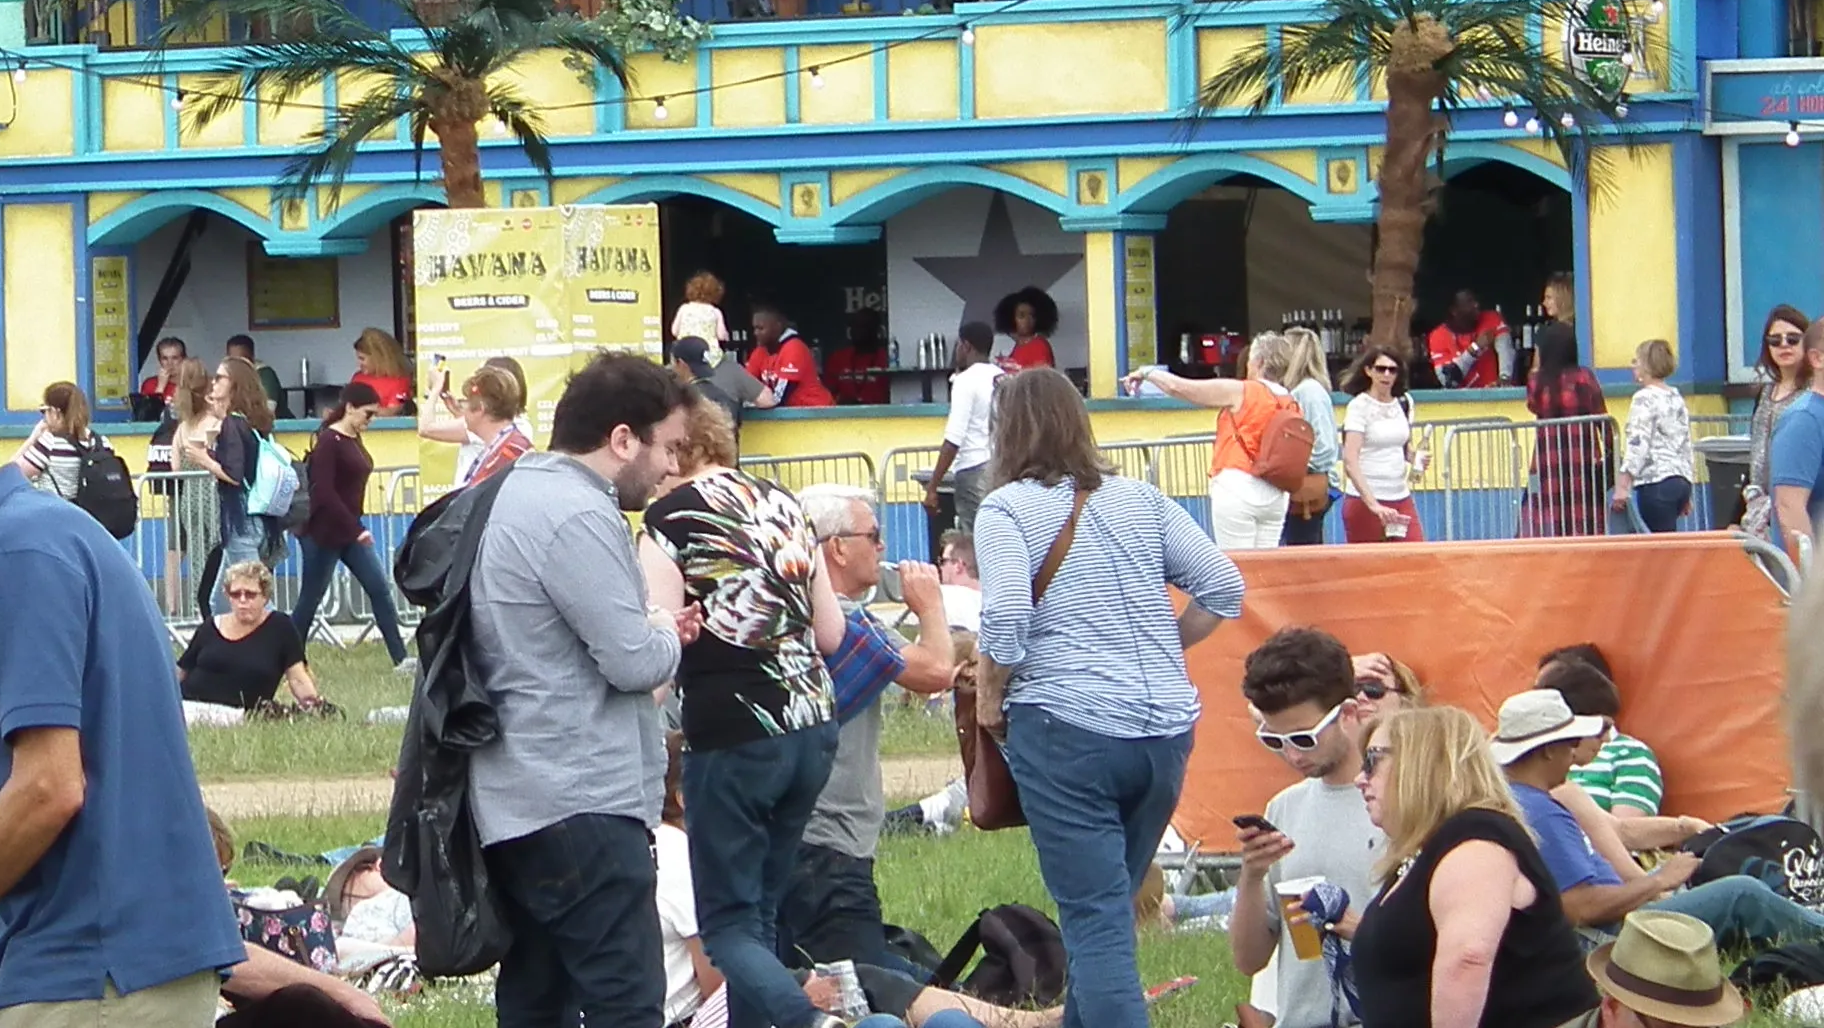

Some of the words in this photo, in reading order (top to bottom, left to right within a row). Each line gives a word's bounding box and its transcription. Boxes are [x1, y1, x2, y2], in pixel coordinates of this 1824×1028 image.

[429, 251, 547, 280] HAVANA
[576, 245, 652, 273] HAVANA
[453, 296, 487, 307] BEERS
[496, 295, 526, 306] CIDER
